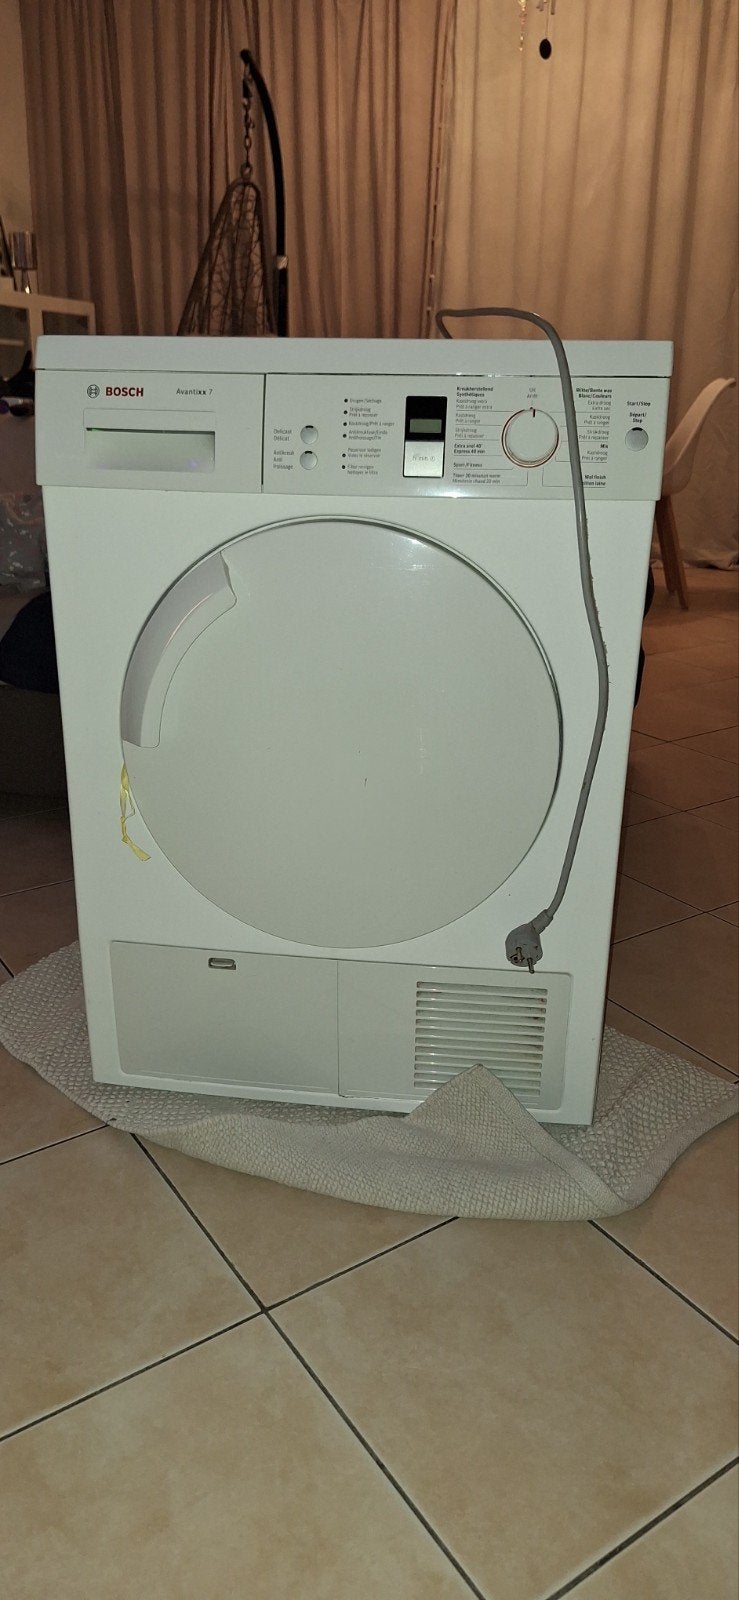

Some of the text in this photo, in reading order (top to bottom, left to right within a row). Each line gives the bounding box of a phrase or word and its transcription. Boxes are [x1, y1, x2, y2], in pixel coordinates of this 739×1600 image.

[105, 386, 144, 397] BOSCH
[176, 388, 213, 396] Avantixx 7
